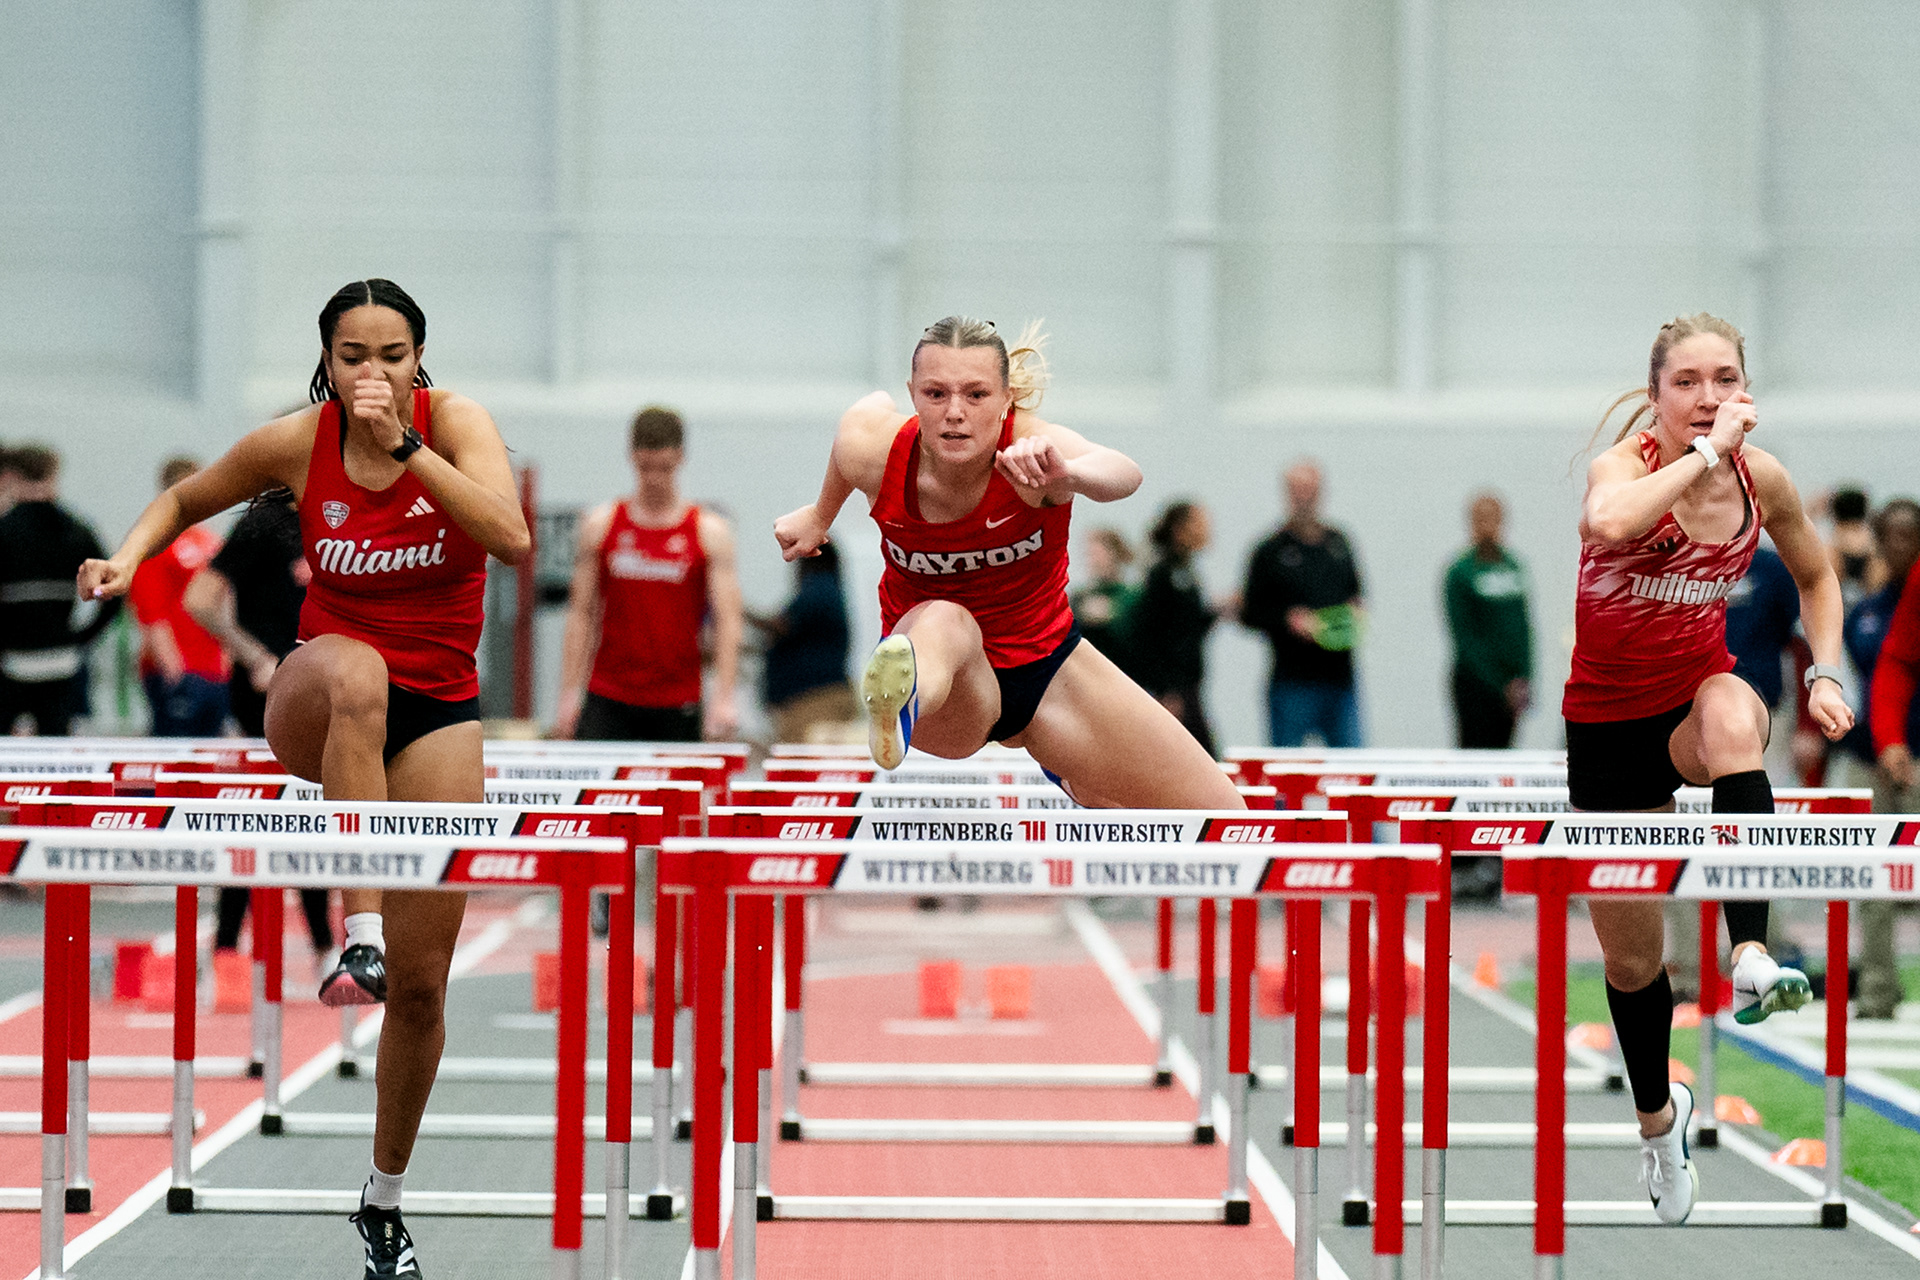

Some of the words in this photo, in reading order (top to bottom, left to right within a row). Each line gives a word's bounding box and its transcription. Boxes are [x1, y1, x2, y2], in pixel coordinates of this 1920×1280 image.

[315, 528, 446, 575] Miami
[885, 529, 1043, 575] DAYTON
[484, 792, 562, 805] VERSITY
[1466, 802, 1576, 813] WITTENBER
[90, 811, 147, 829] GILL
[185, 813, 327, 833] WITTENBERG
[369, 815, 499, 836] UNIVERSITY
[534, 819, 592, 837] GILL
[778, 822, 834, 840] GILL
[872, 822, 1013, 841] WITTENBERG
[1056, 823, 1184, 843] UNIVERSITY
[1220, 825, 1276, 843] GILL
[1471, 827, 1527, 844] GILL
[1563, 826, 1705, 845] WITTENBERG
[1747, 828, 1877, 846] UNIVERSITY
[43, 846, 216, 872] WITTENBERG
[267, 851, 425, 877] UNIVERSITY
[467, 854, 539, 880] GILL
[748, 857, 819, 883] GILL
[863, 860, 1034, 884] WITTENBERG
[1084, 861, 1241, 887] UNIVERSITY
[1283, 863, 1353, 888] GILL
[1587, 863, 1659, 889] GILL
[1702, 865, 1874, 890] WITTENBERG
